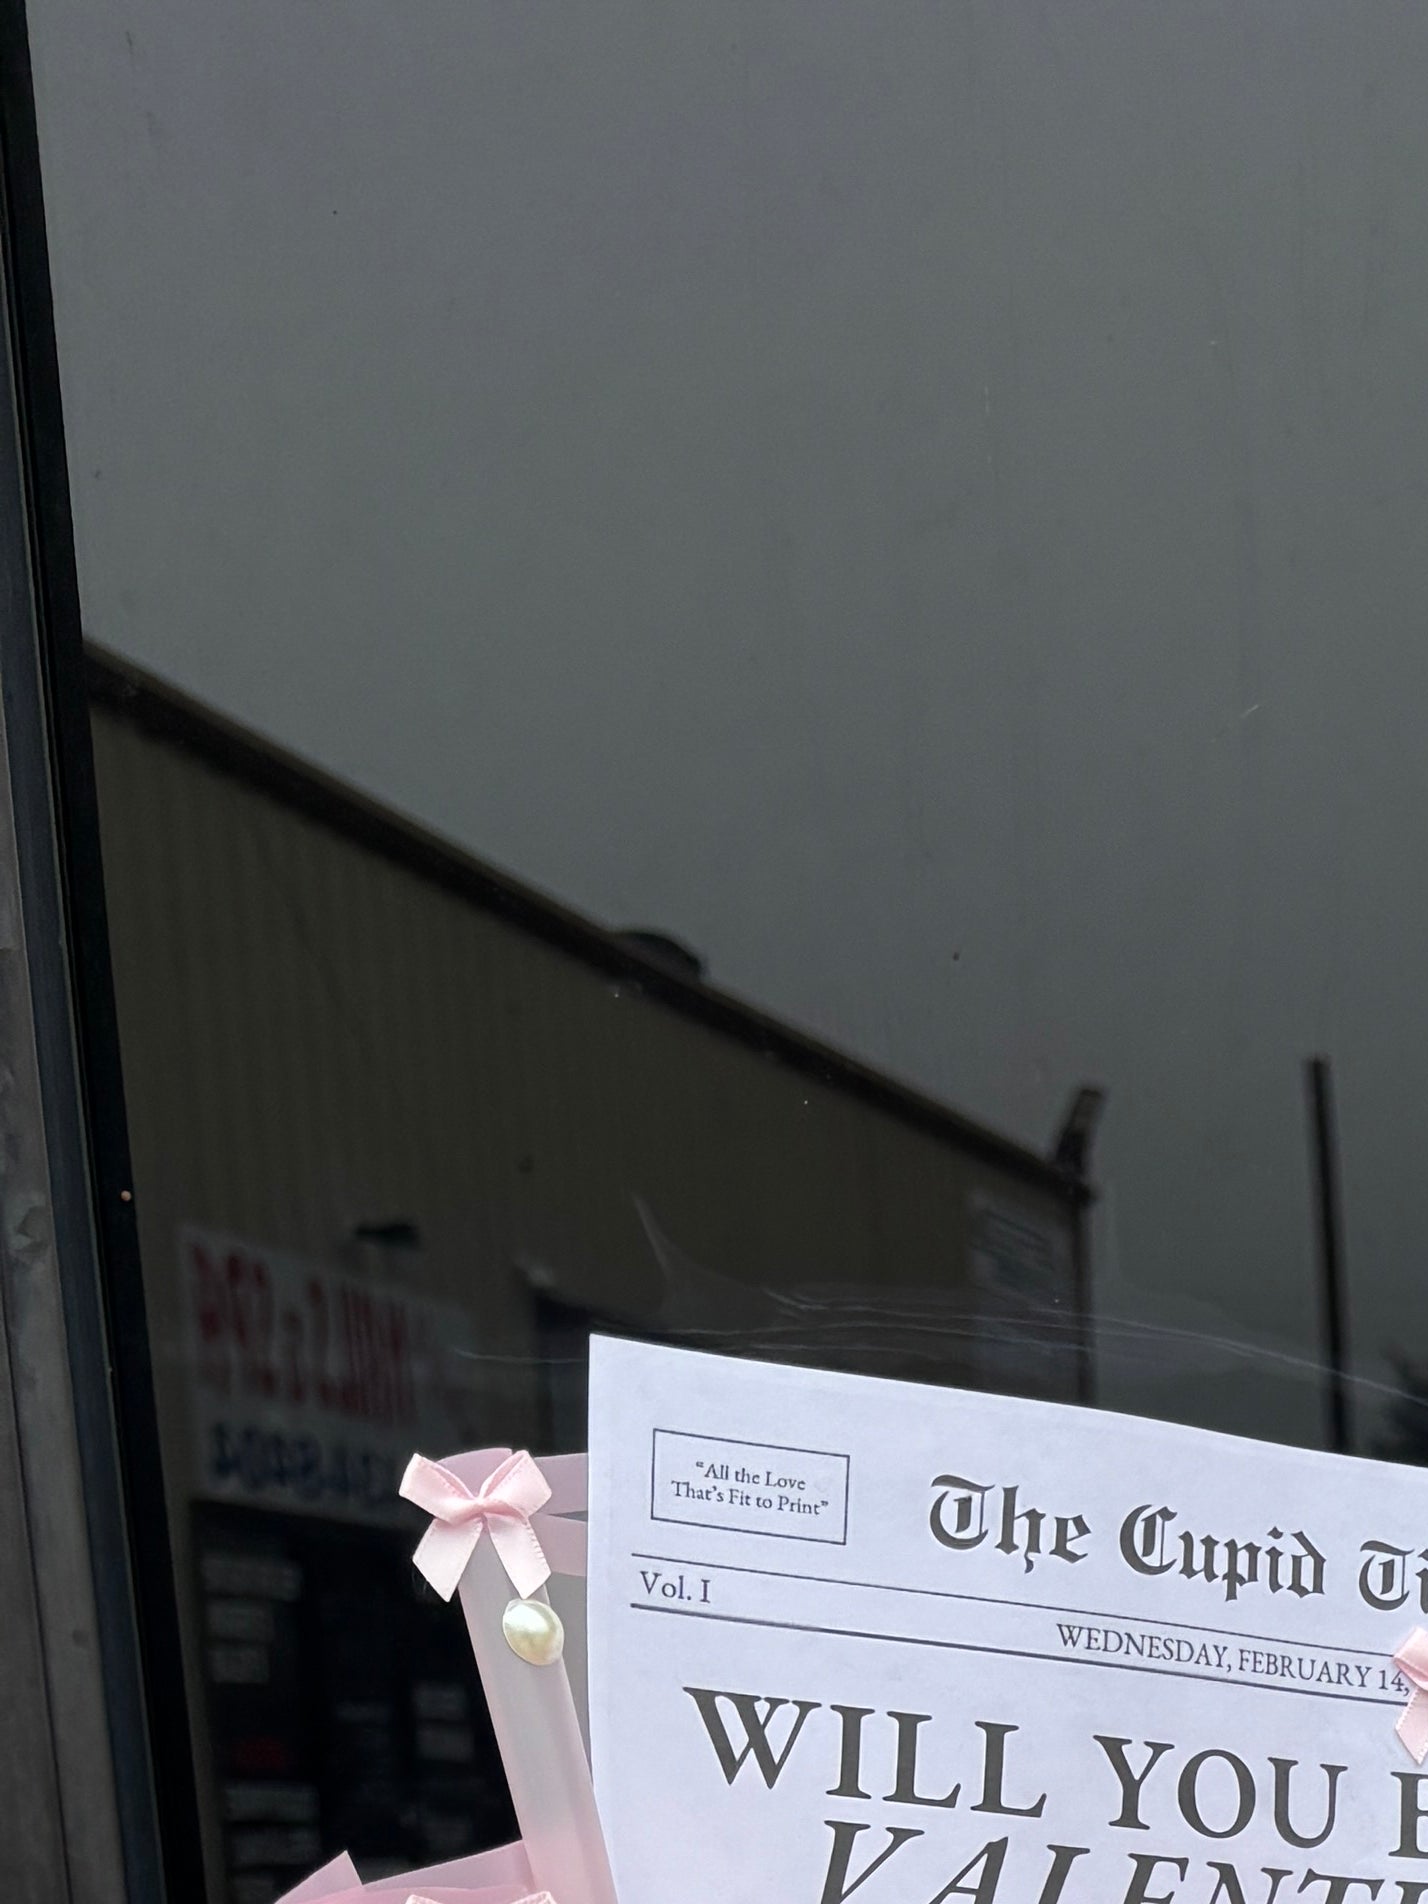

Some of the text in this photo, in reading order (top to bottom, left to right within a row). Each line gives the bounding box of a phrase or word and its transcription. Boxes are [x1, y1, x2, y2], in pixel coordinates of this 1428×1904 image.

[729, 1489, 751, 1507] Fit
[756, 1496, 773, 1509] to
[735, 1468, 760, 1484] the
[765, 1471, 806, 1491] Love
[930, 1475, 1091, 1573] The
[1119, 1504, 1327, 1602] Cupid
[639, 1570, 711, 1604] Vol. I
[1057, 1623, 1410, 1697] WEDNESDAY, FEBRUARY 14,
[683, 1686, 1047, 1818] WILL
[1093, 1734, 1348, 1849] YOU
